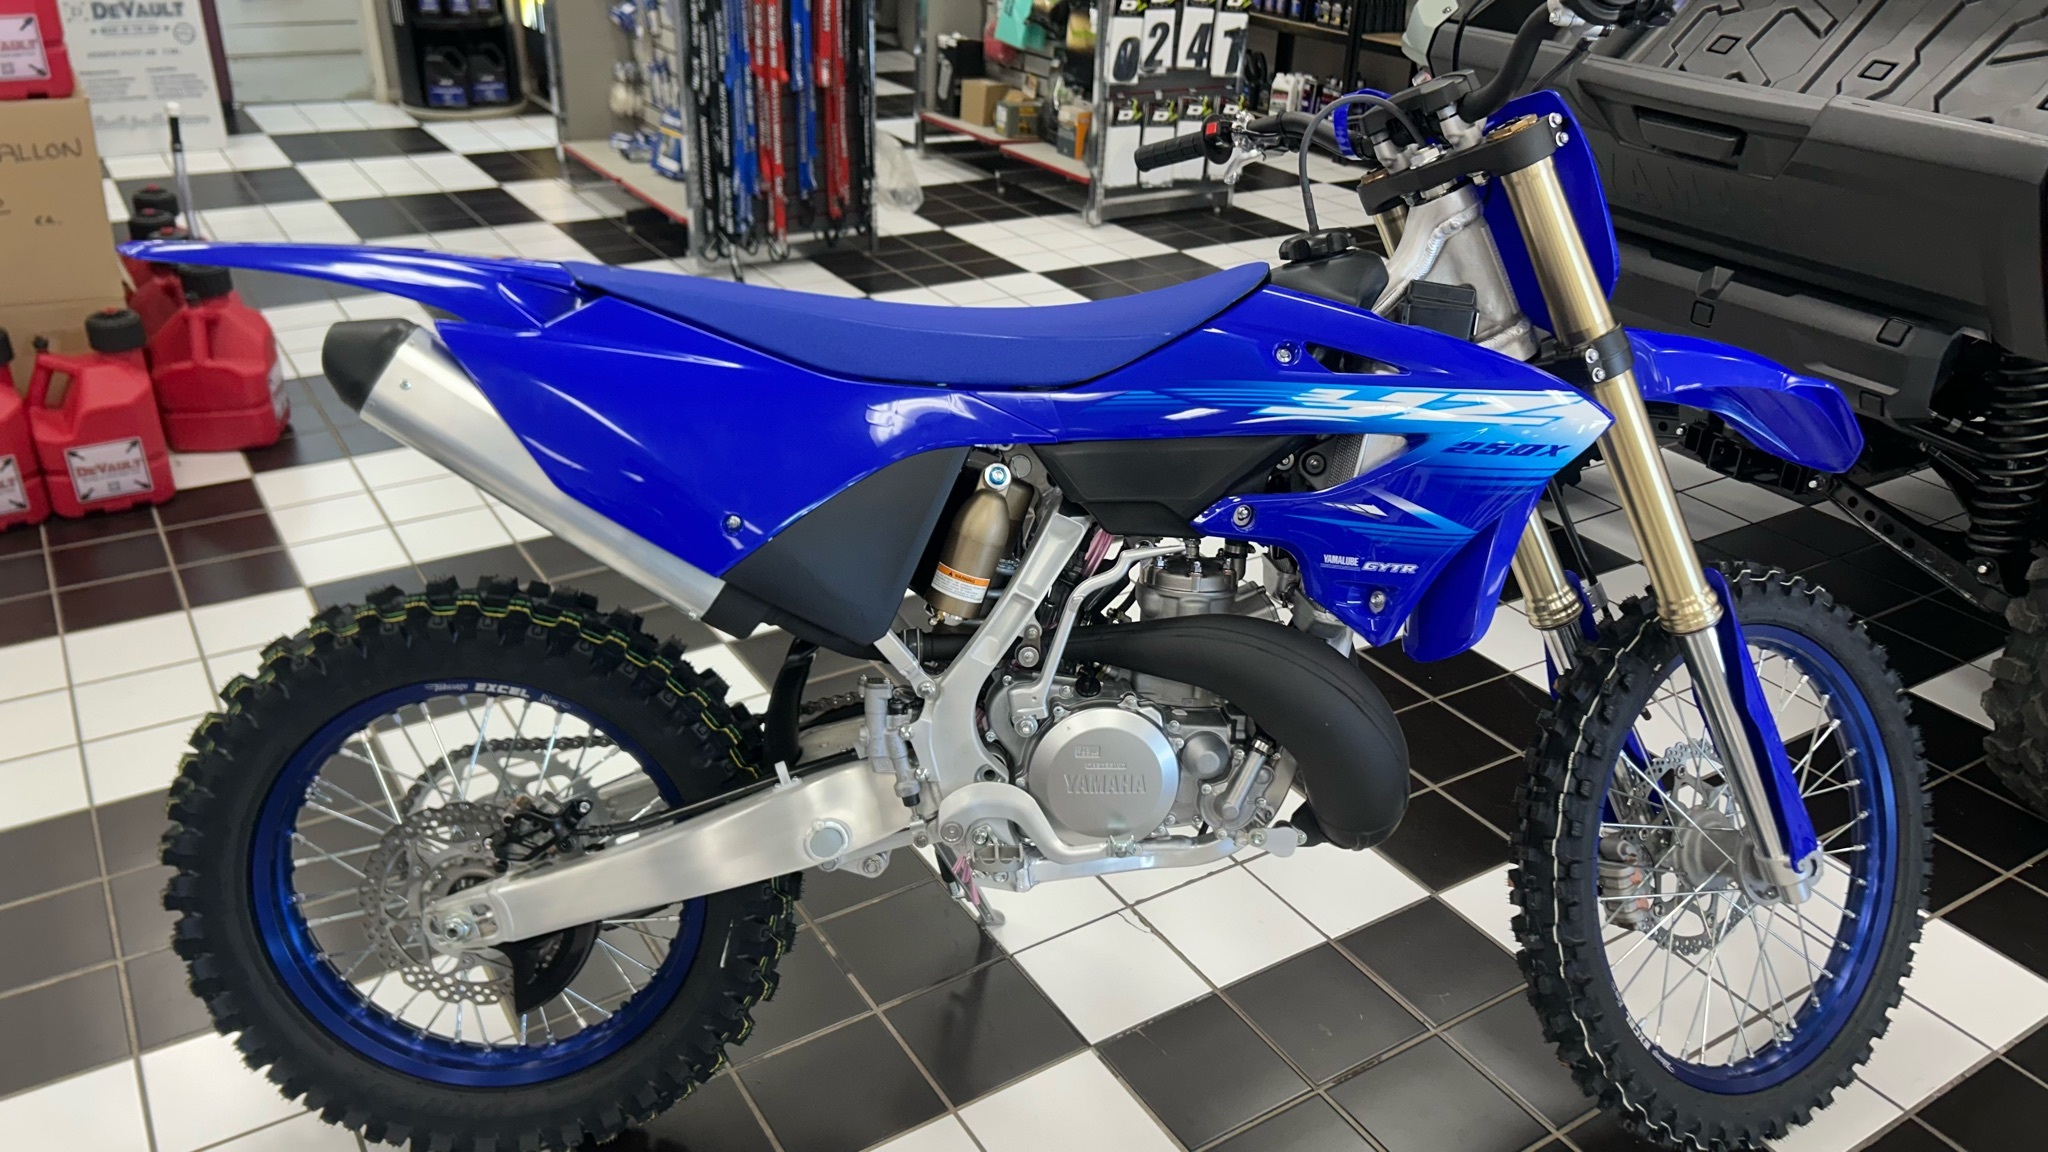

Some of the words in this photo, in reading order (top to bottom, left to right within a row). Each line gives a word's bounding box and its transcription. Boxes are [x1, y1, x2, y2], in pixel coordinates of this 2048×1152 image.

[1113, 36, 1141, 82] 0
[1144, 21, 1170, 68] 2
[1186, 23, 1213, 67] 4
[1224, 27, 1248, 74] 1
[1440, 441, 1571, 457] 250X
[1323, 554, 1359, 567] YAMALUBE
[1361, 561, 1419, 574] GYTR
[474, 682, 531, 698] EXCEL
[1064, 774, 1146, 794] YAMAHA
